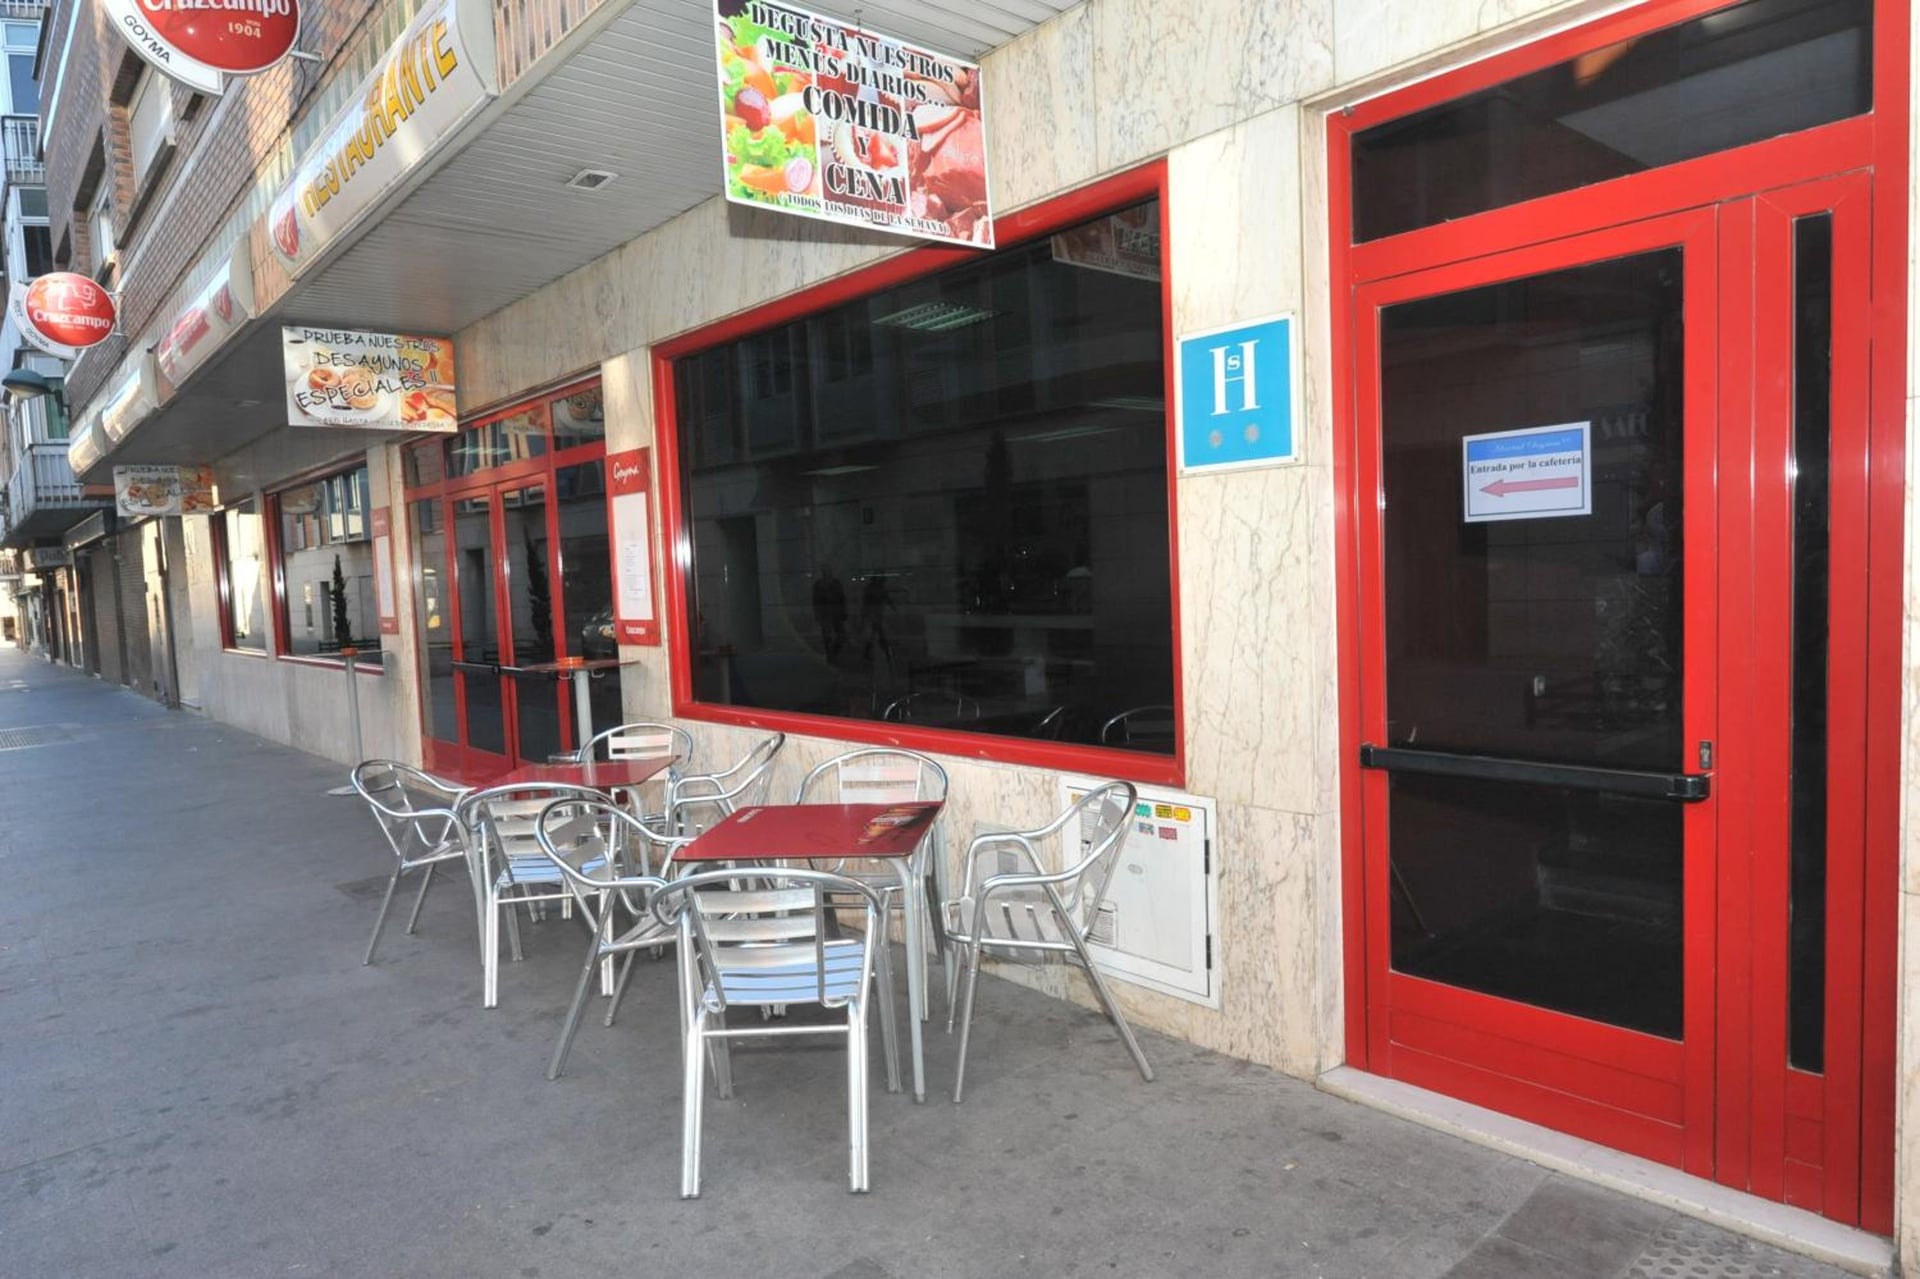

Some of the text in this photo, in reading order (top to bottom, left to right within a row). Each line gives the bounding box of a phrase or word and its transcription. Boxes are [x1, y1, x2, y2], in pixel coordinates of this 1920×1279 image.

[123, 15, 170, 64] GOYMA
[227, 22, 262, 39] 1904
[751, 4, 955, 83] DEGUSTA NUESTROS
[802, 86, 920, 141] COMIDA
[858, 137, 869, 156] Y
[826, 163, 906, 205] CENA
[304, 329, 440, 352] PRUEBA NUESTROS
[313, 351, 424, 375] DESAYUNOS
[296, 374, 427, 408] ESPECIALES
[1470, 464, 1507, 474] Entrada
[1509, 461, 1525, 472] por
[1528, 459, 1537, 468] la
